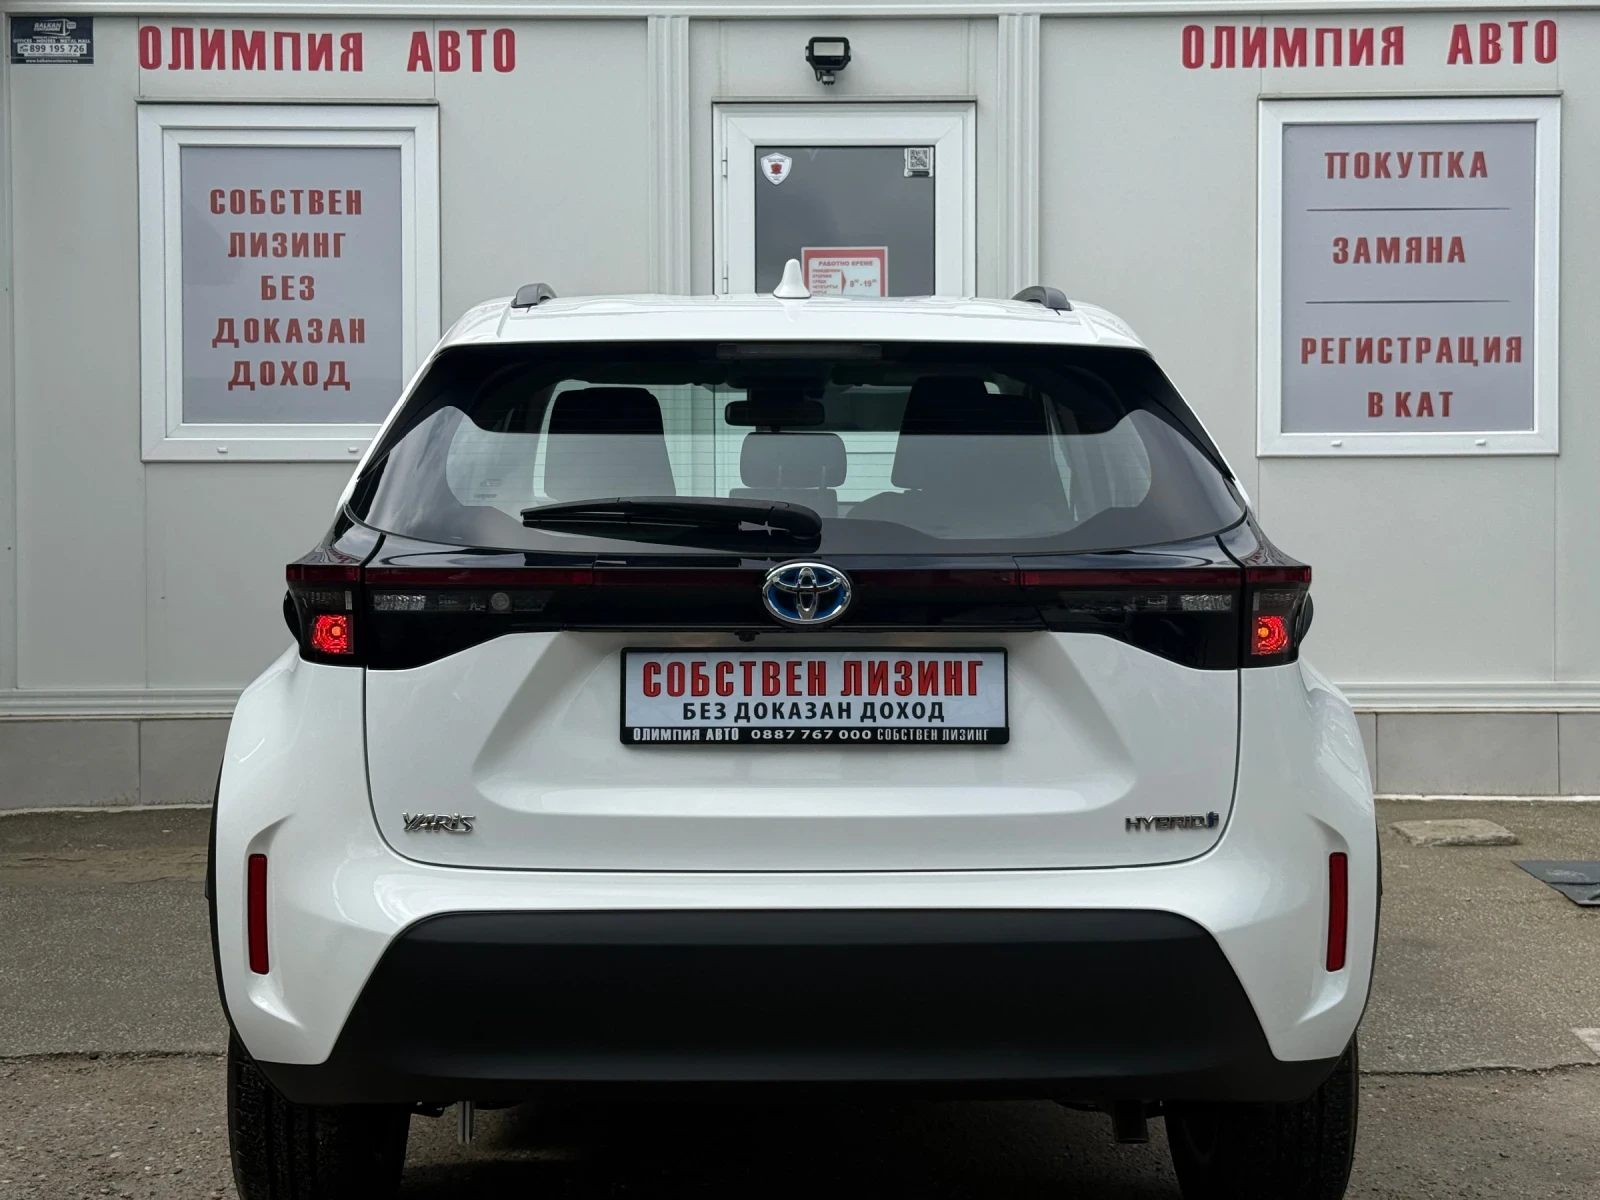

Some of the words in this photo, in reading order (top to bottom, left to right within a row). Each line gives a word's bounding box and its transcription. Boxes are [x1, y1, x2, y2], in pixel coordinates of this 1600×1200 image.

[29, 44, 46, 53] 899
[49, 44, 65, 53] 195
[68, 44, 85, 53] 726
[139, 26, 363, 72] ОЛИМПИЯ
[407, 28, 516, 73] АВТО
[1182, 25, 1405, 69] ОЛИМПИЯ
[1447, 20, 1558, 65] АВТО
[1325, 151, 1489, 179] ПОКУПКА
[210, 189, 363, 216] СОБСТВЕН
[228, 232, 347, 258] ЛИЗИНГ
[1332, 237, 1466, 264] ЗАМЯНА
[261, 276, 315, 301] БЕЗ
[212, 318, 365, 348] ДОКАЗАН
[1301, 337, 1522, 367] РЕГИСТРАЦИЯ
[228, 360, 350, 391] ДОХОД
[1368, 391, 1384, 418] В
[1395, 391, 1454, 418] КАТ
[643, 661, 827, 697] СОБСТВЕН
[841, 661, 983, 696] ЛИЗИНГ
[683, 702, 727, 720] БЕЗ
[734, 702, 852, 723] ДОКАЗАН
[860, 702, 945, 722] ДОХОД
[633, 728, 700, 741] ОЛИМПИЯ
[706, 728, 739, 741] АВТО
[751, 730, 796, 740] 0887
[801, 730, 834, 740] 767
[839, 730, 872, 740] 000
[877, 729, 938, 741] СОБСТВЕН
[942, 729, 988, 741] ЛИЗИНГ
[1125, 814, 1206, 832] HYBRID
